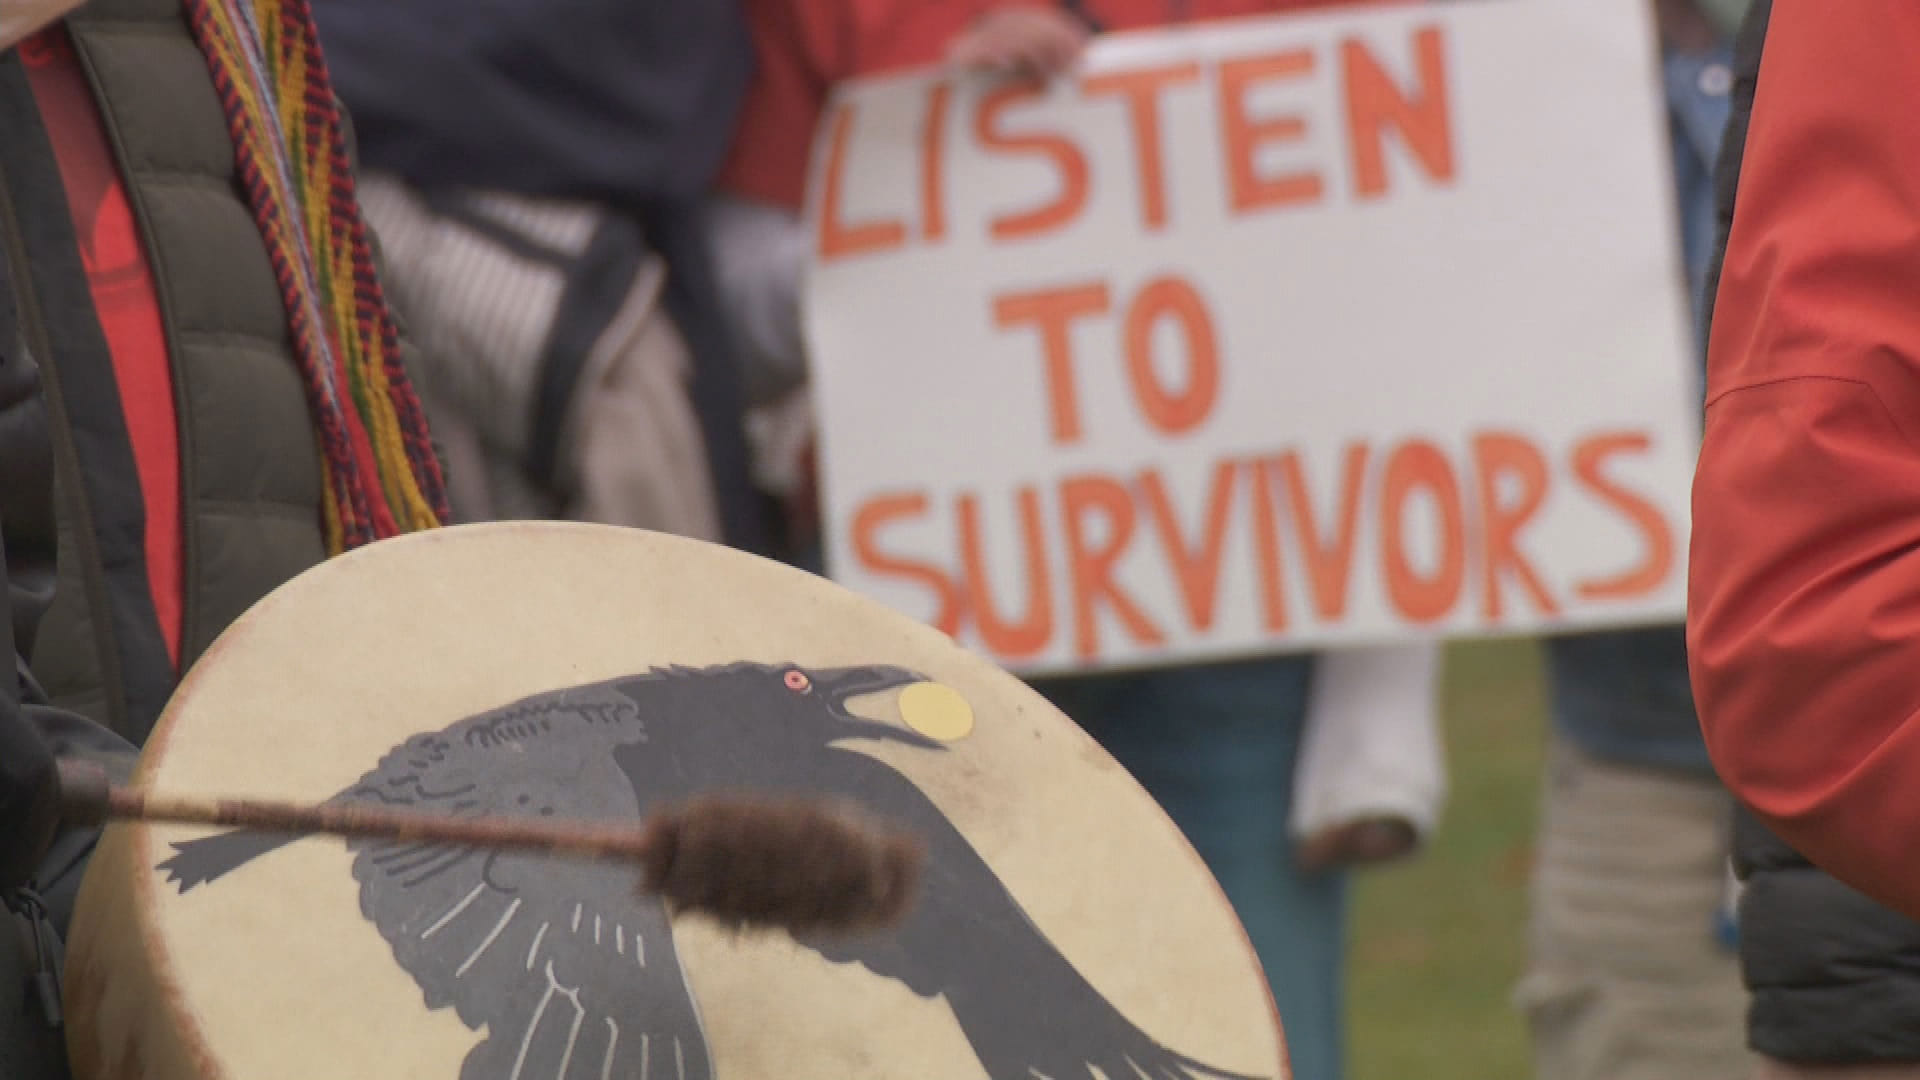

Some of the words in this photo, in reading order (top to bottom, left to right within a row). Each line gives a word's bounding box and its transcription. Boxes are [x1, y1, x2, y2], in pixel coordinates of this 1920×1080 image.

[818, 27, 1454, 261] LISTEN
[993, 277, 1220, 442] TO
[850, 433, 1674, 659] SURVIVORS
